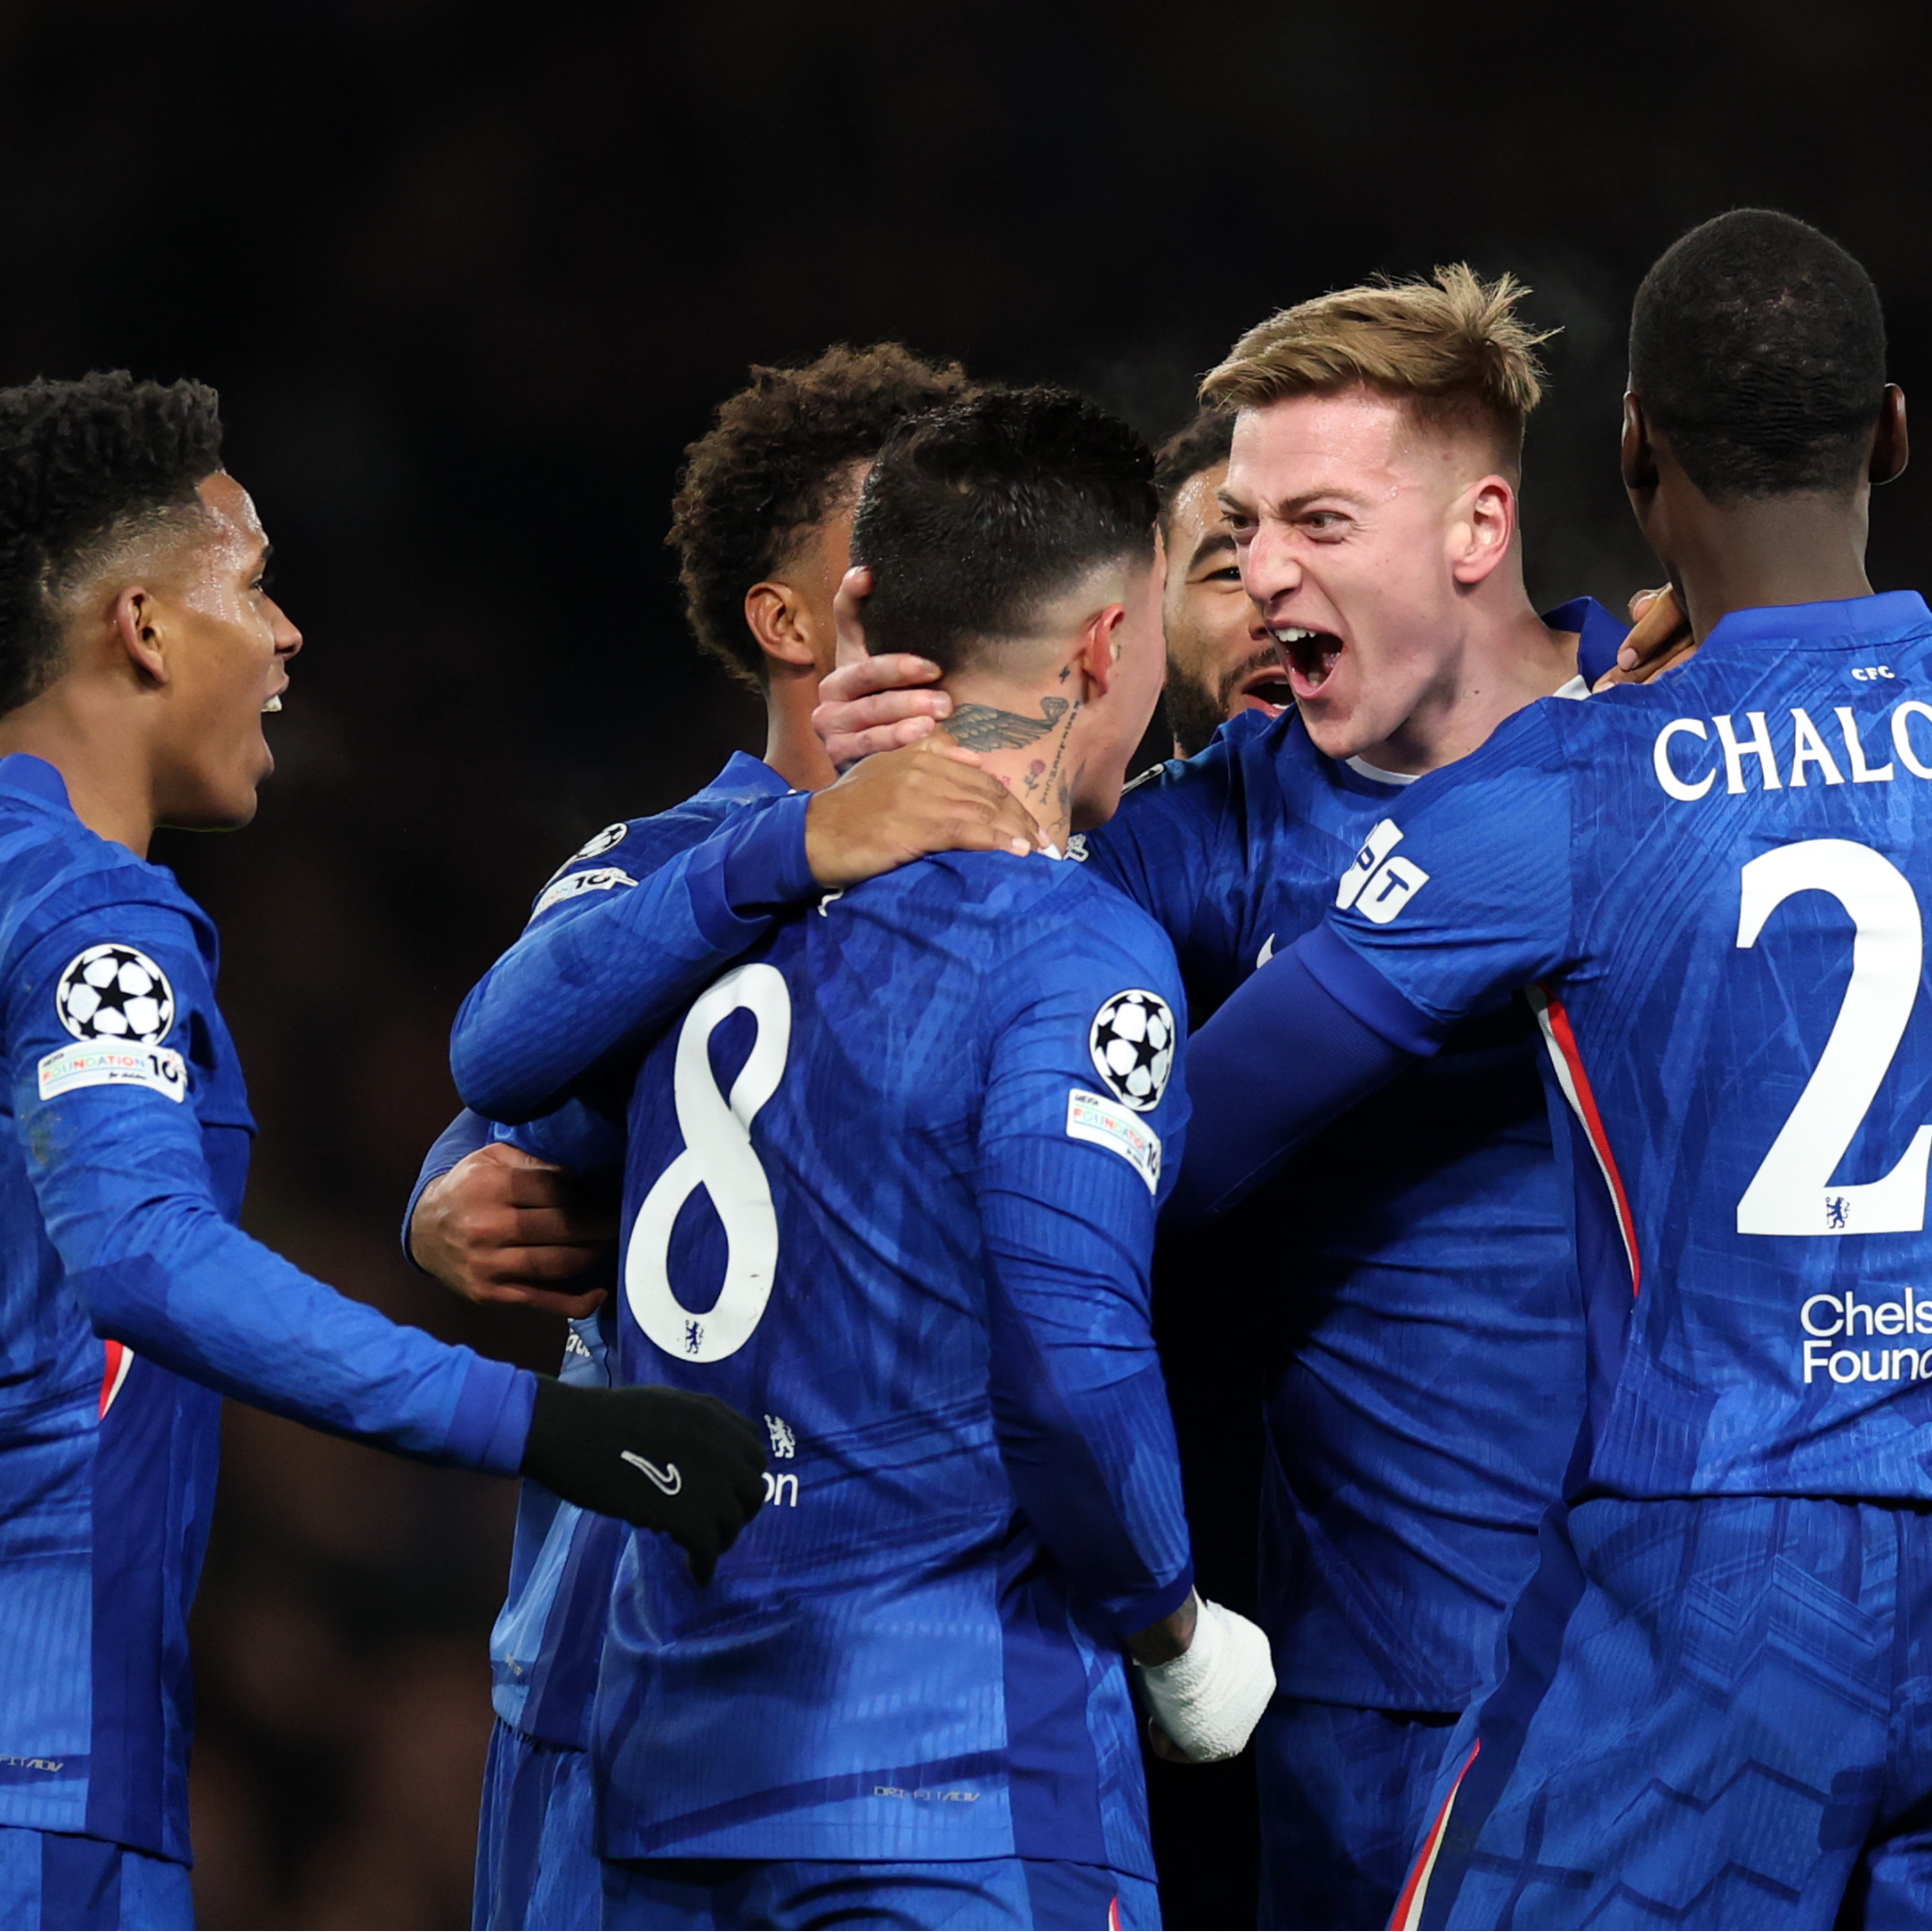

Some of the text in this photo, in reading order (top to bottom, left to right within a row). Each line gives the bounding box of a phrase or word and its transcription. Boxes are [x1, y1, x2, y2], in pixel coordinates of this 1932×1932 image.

[1851, 665, 1896, 682] CFC
[1653, 700, 1932, 802] CHALO
[1735, 837, 1932, 1235] 2
[43, 1055, 145, 1081] FOUNDATION
[1074, 1094, 1100, 1106] UEFA
[625, 962, 791, 1363] 8
[1800, 1287, 1932, 1338] Chels
